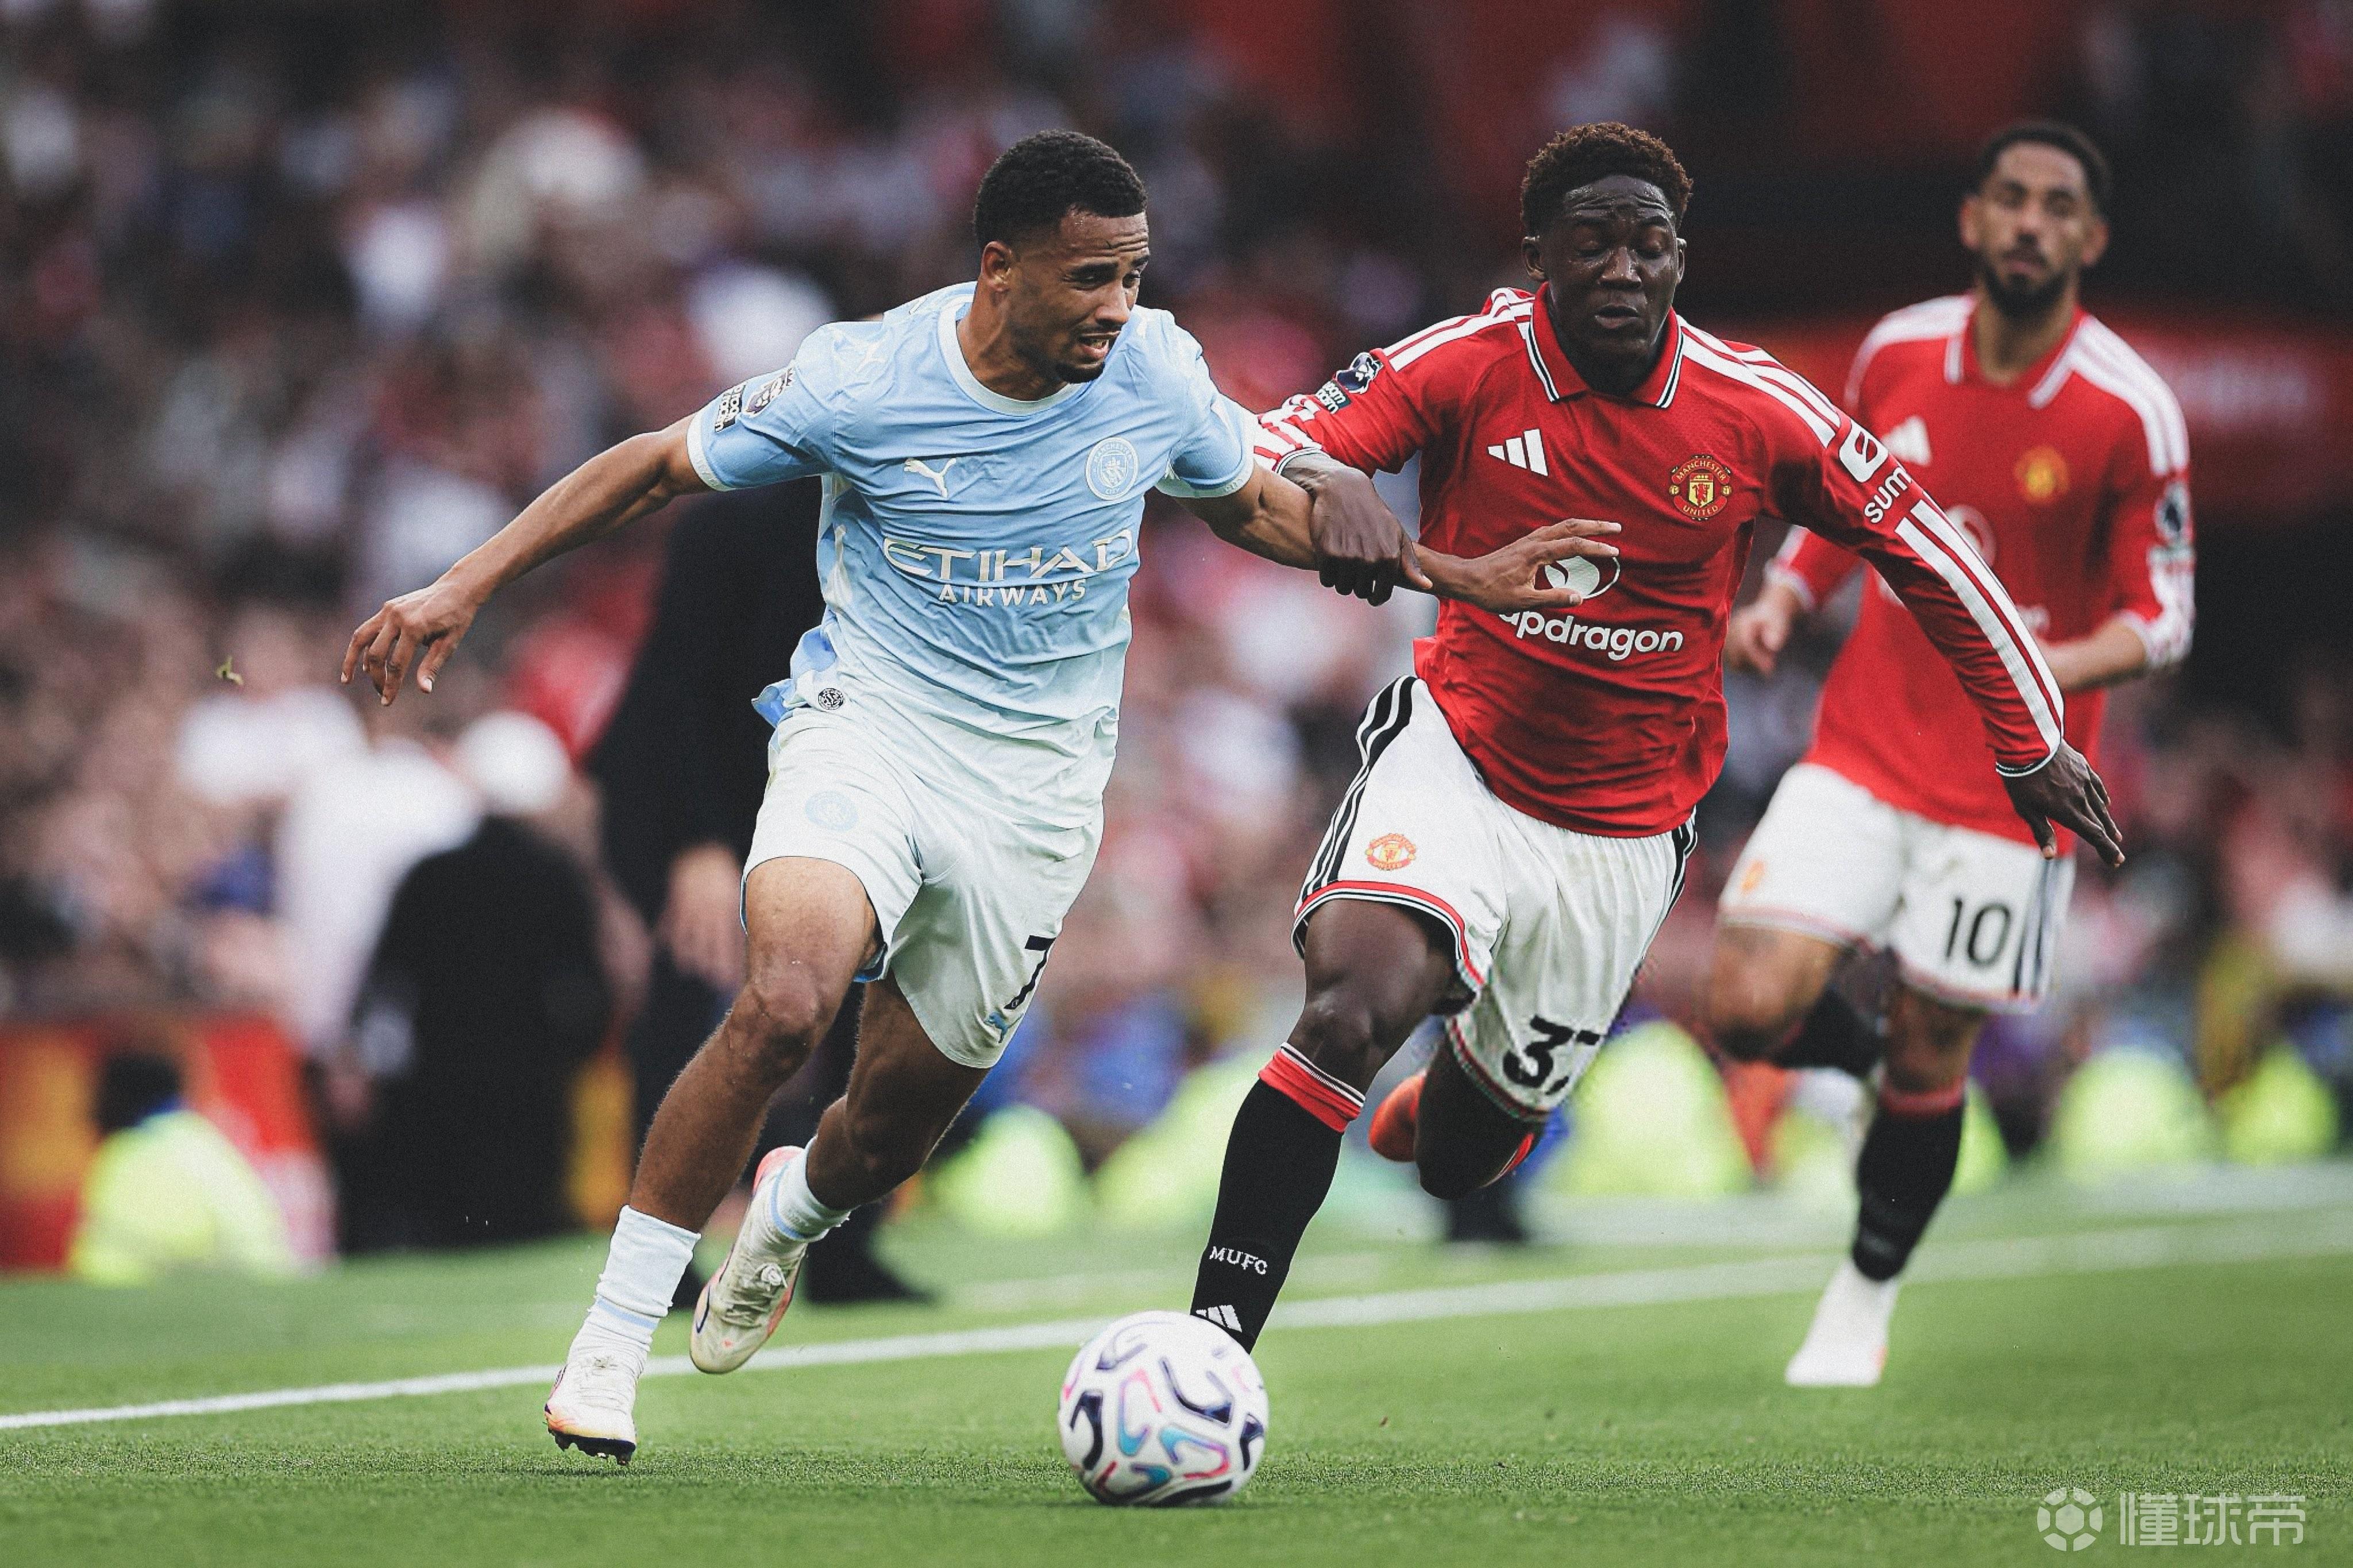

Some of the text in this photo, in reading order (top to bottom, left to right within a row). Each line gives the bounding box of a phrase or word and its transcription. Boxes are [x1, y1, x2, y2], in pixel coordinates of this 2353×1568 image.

[1676, 460, 1726, 481] MANCHESTER
[1683, 505, 1718, 516] UNITED
[884, 529, 1133, 582] ETIHAD
[939, 578, 1086, 607] AIRWAYS
[1944, 898, 2012, 970] 10
[1209, 1246, 1268, 1275] MUFC
